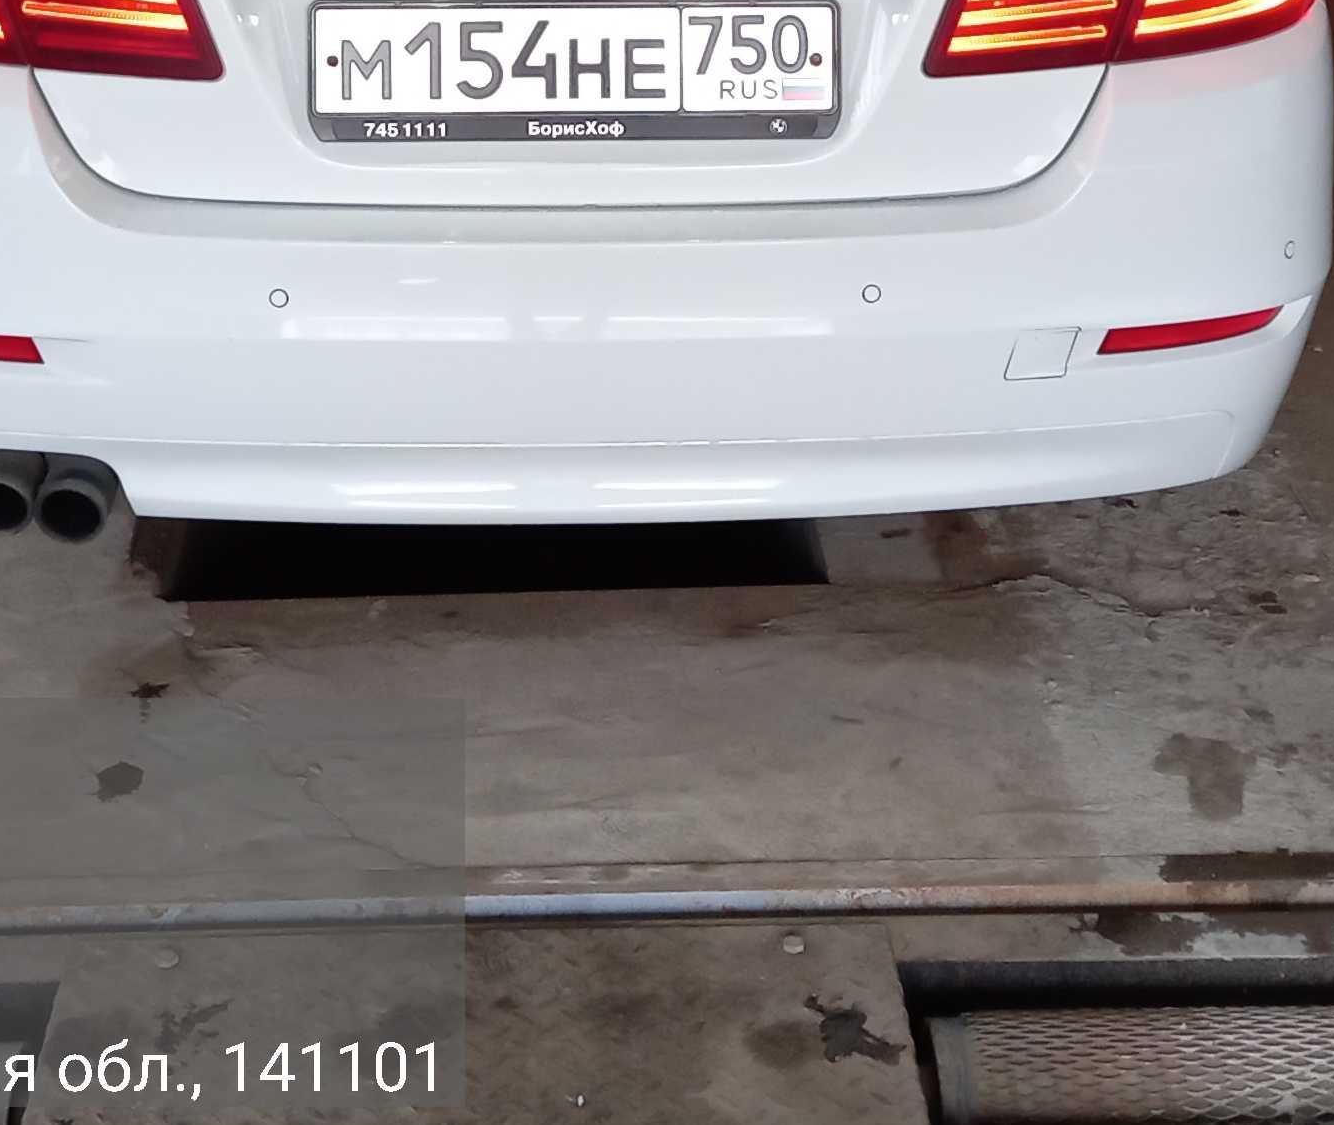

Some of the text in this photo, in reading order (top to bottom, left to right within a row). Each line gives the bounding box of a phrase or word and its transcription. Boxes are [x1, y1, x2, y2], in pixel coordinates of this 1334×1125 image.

[341, 15, 808, 100] М154НЕ 750
[720, 80, 777, 99] RUS
[528, 121, 625, 138] БорисХоф
